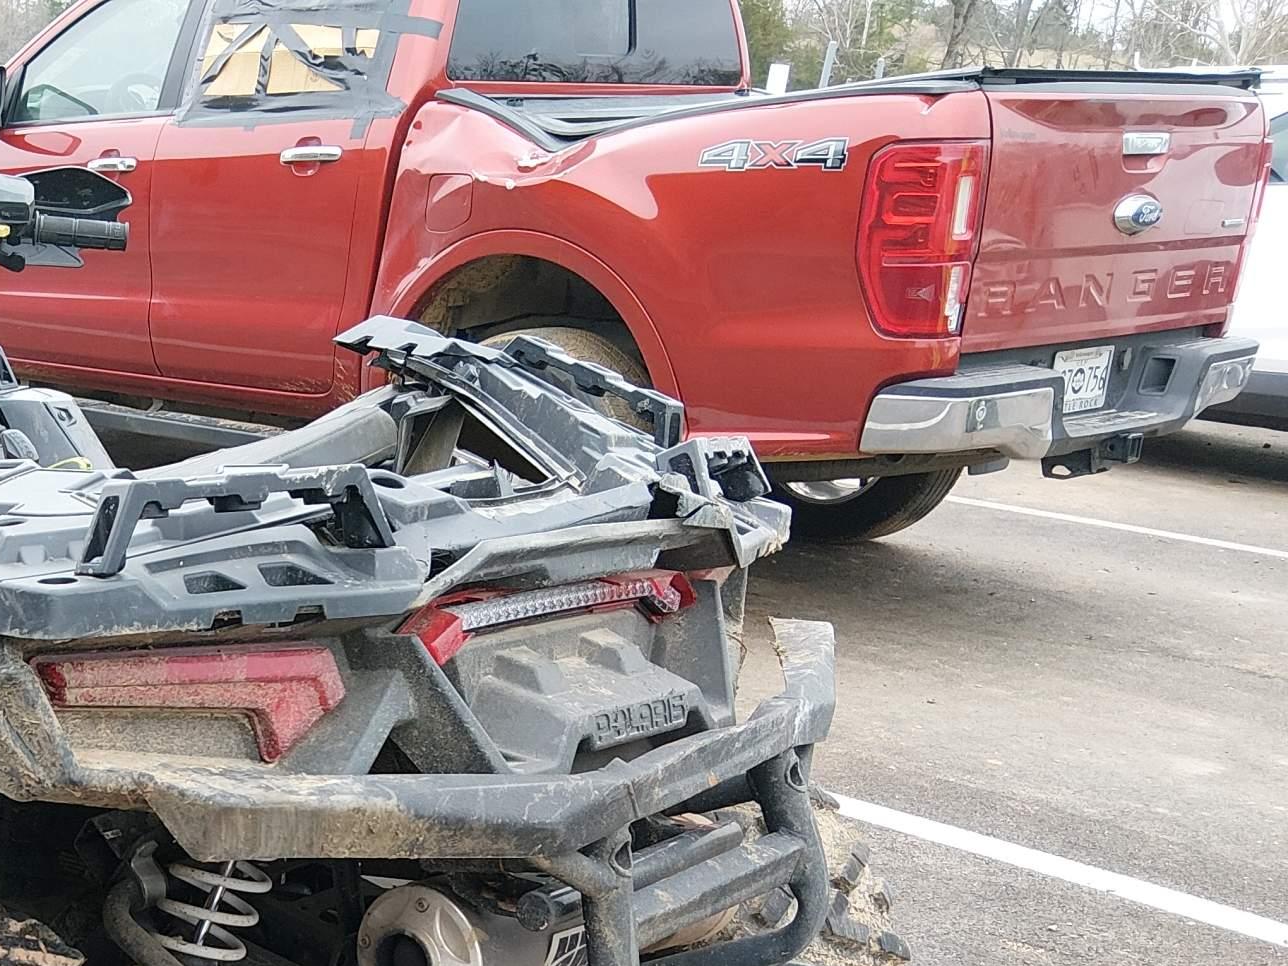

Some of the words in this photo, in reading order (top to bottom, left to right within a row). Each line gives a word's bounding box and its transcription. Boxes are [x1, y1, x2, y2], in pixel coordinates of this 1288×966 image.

[698, 136, 849, 172] 4X4
[977, 260, 1226, 317] RANGER
[594, 692, 686, 743] POLARIS
